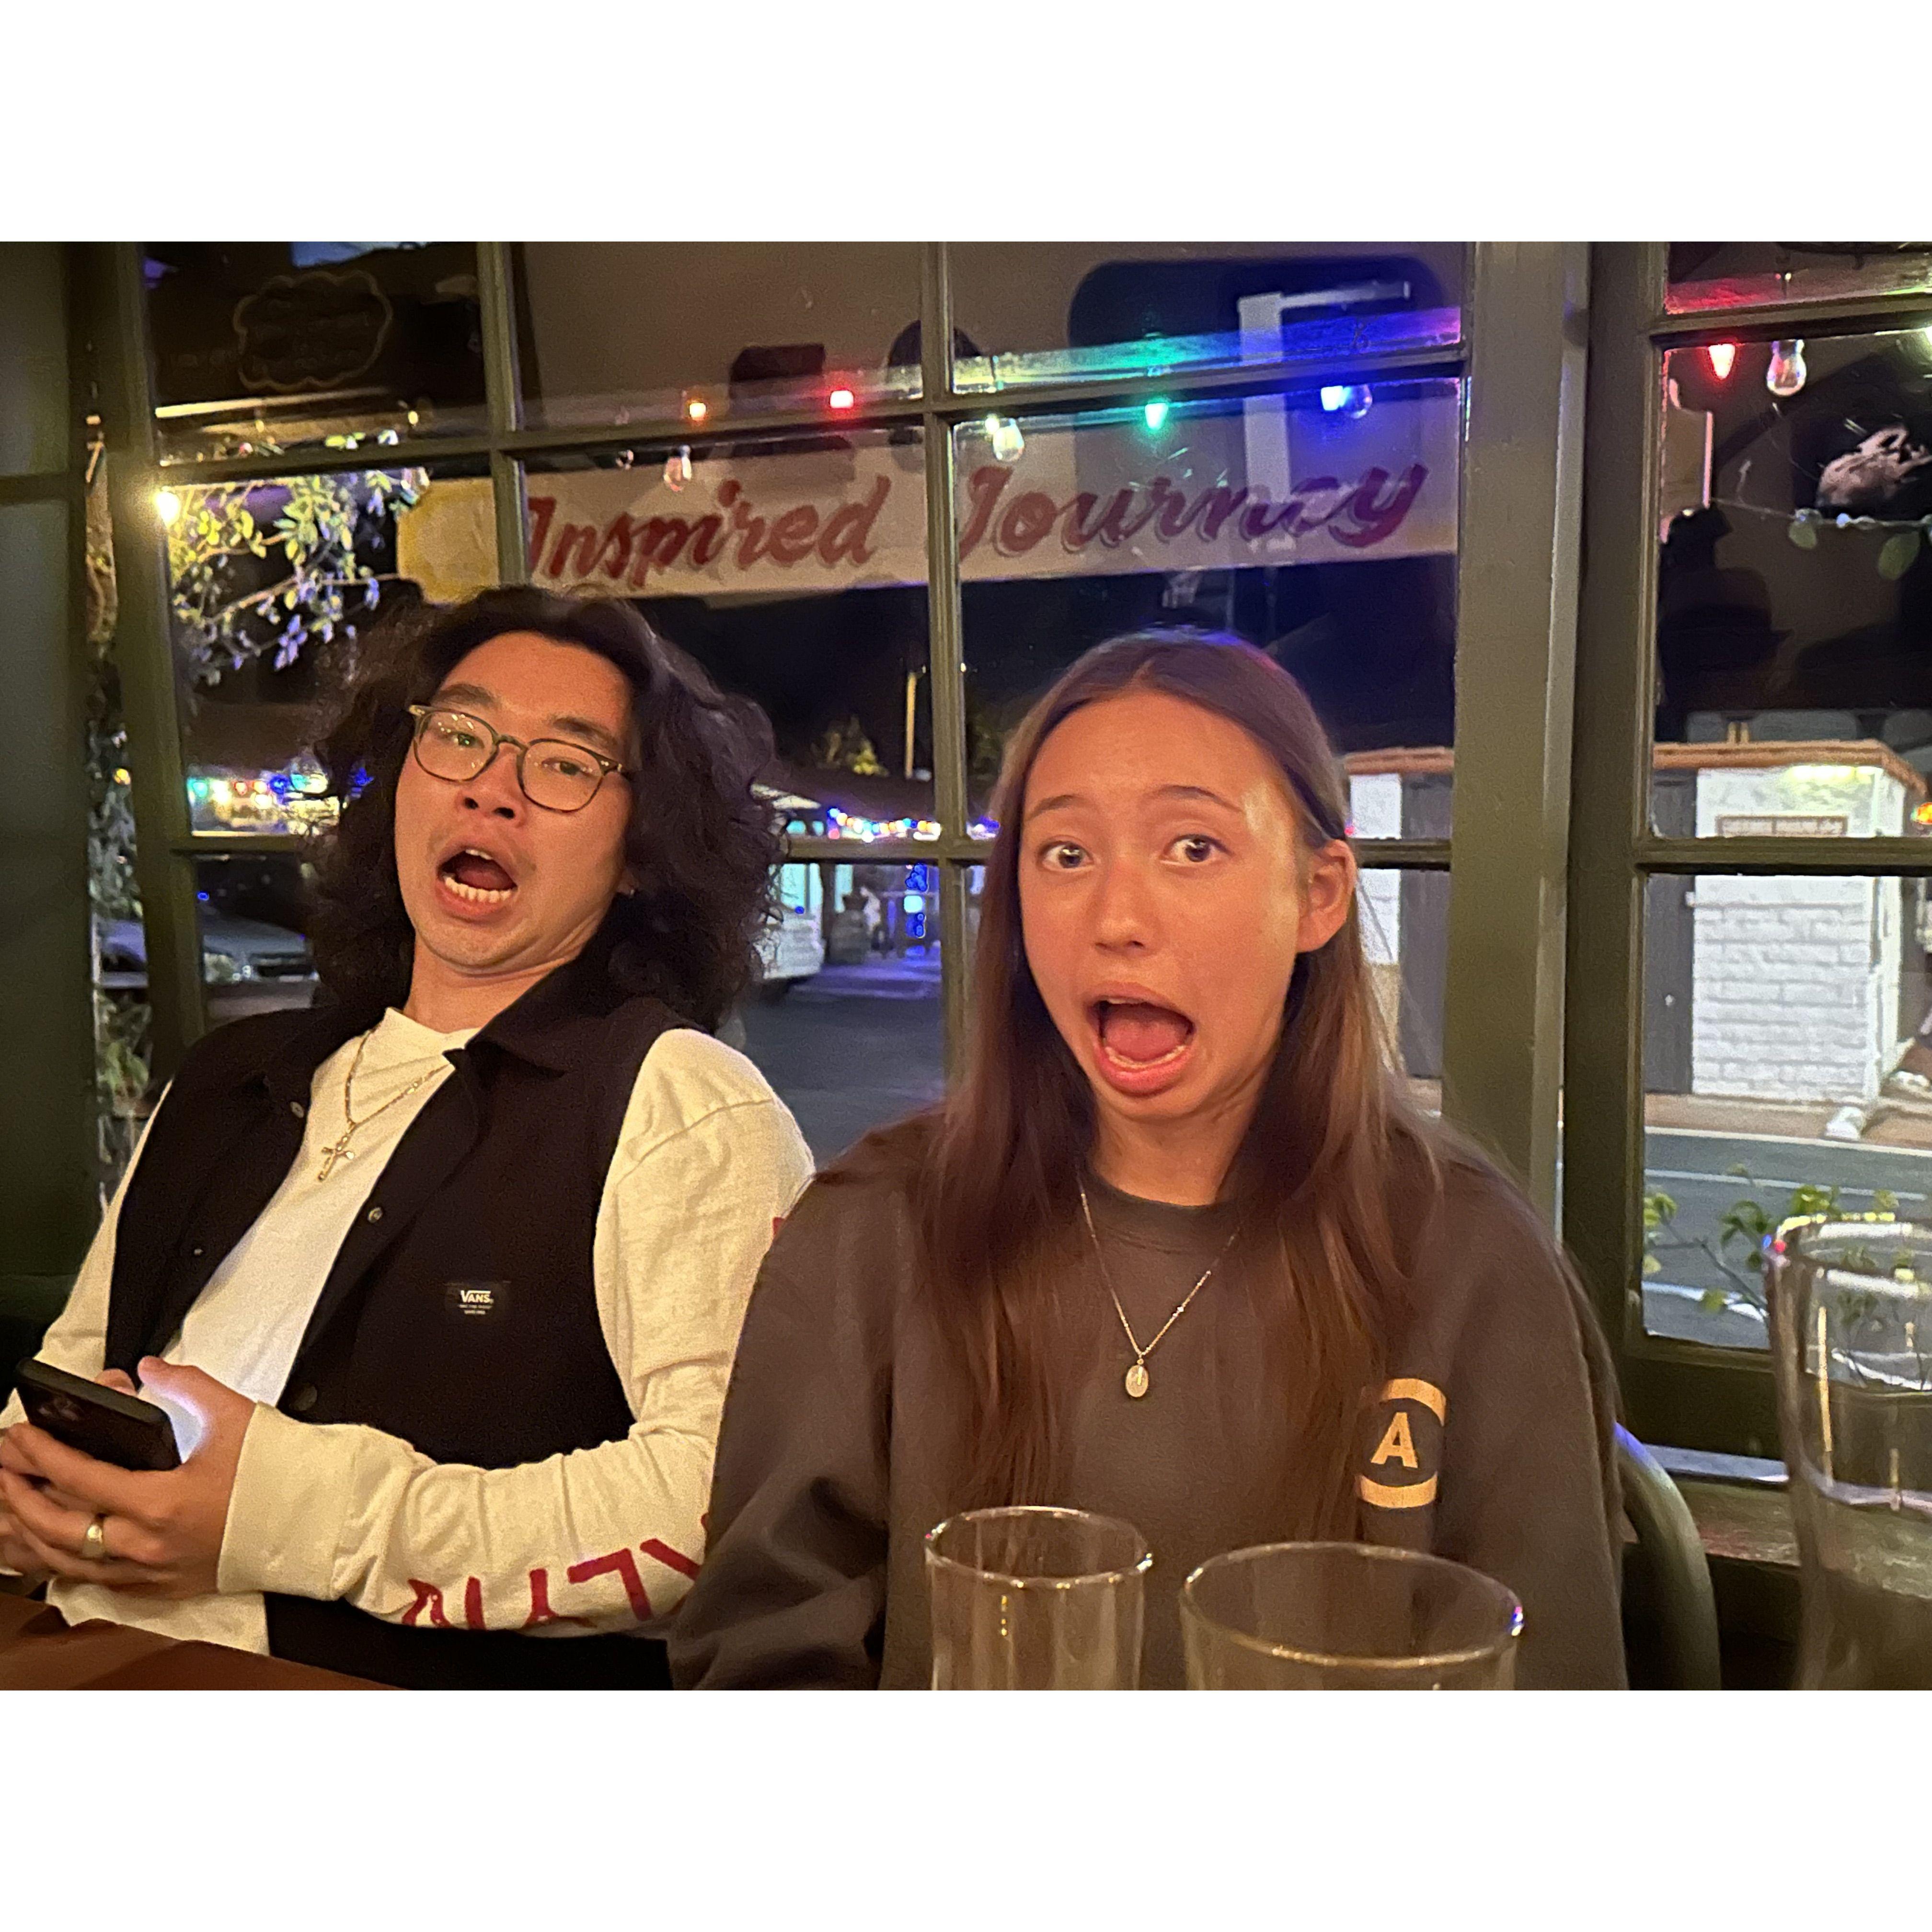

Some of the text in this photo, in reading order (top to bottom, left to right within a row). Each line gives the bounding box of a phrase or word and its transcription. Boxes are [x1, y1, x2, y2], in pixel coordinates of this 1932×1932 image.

[528, 463, 1429, 589] Inspired Journey
[460, 1290, 491, 1303] VANS
[1371, 1412, 1418, 1468] A
